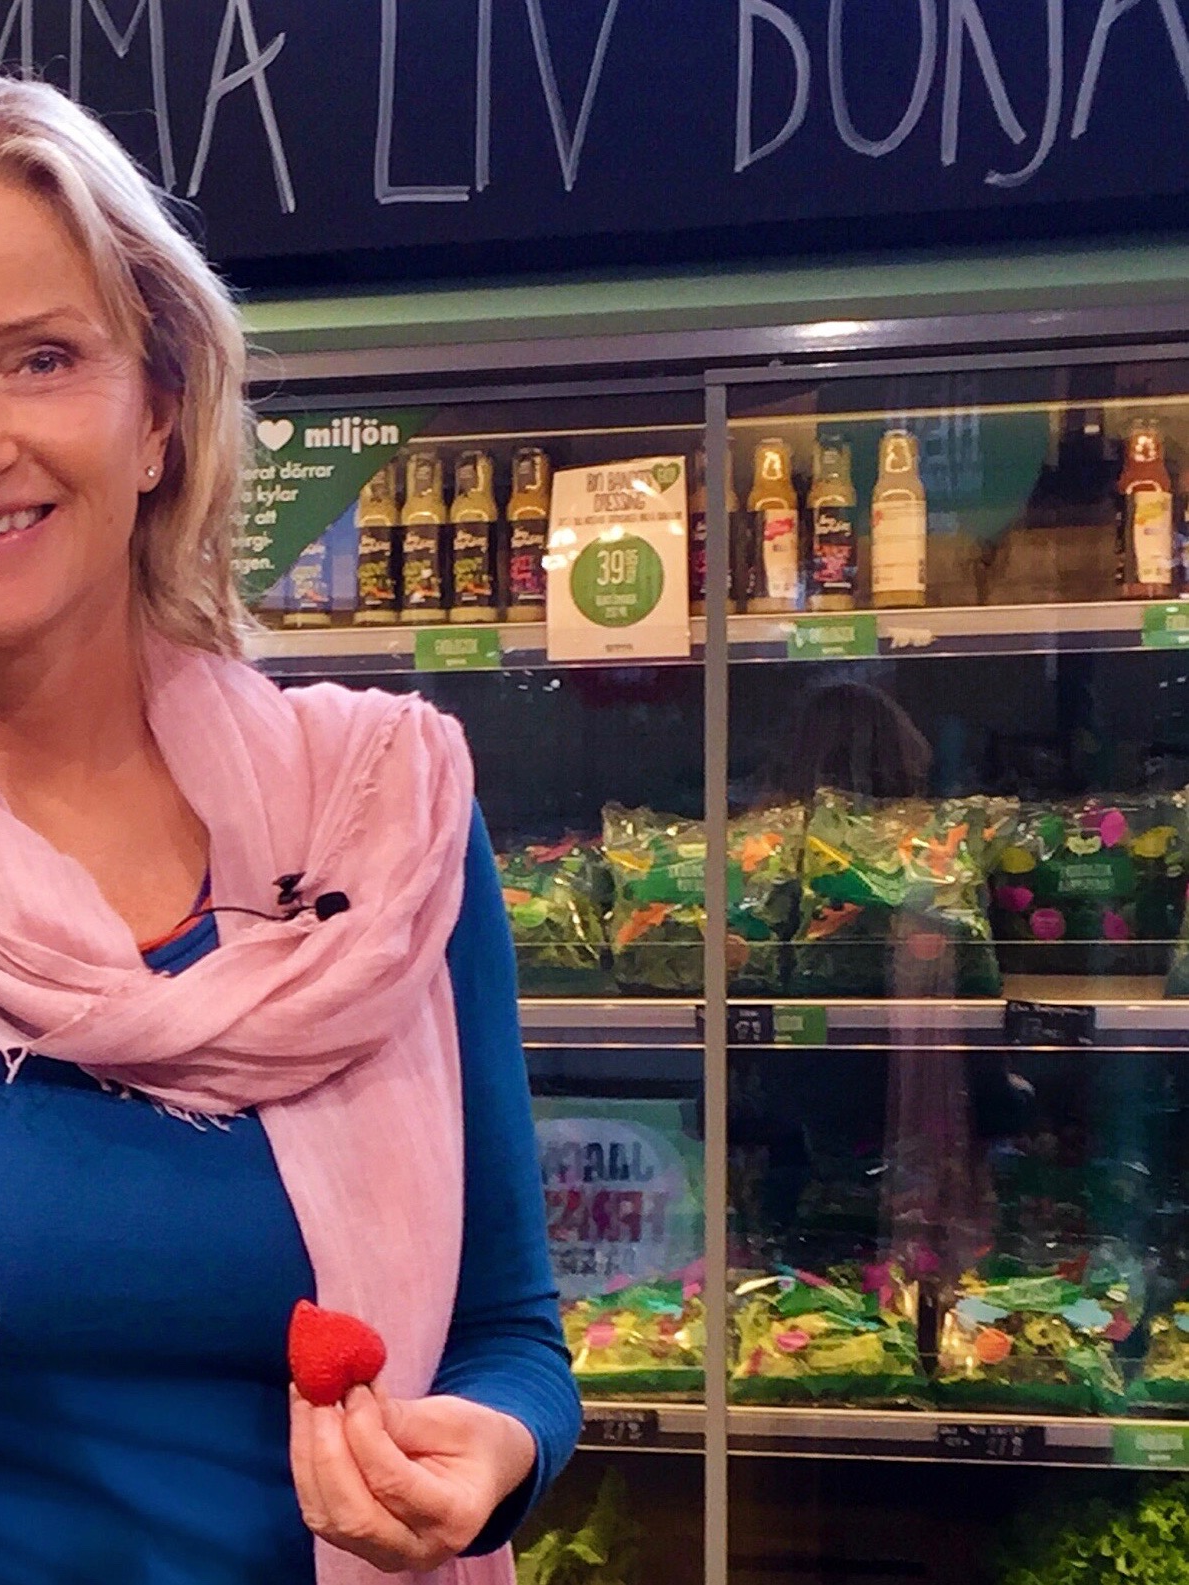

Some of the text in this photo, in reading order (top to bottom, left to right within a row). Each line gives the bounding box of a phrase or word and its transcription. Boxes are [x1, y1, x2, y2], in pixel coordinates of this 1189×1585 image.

[374, 0, 618, 205] LIV
[304, 416, 399, 453] miljön
[279, 461, 335, 479] dörrar
[257, 484, 299, 507] kylar
[254, 510, 277, 525] att
[596, 549, 624, 586] 39
